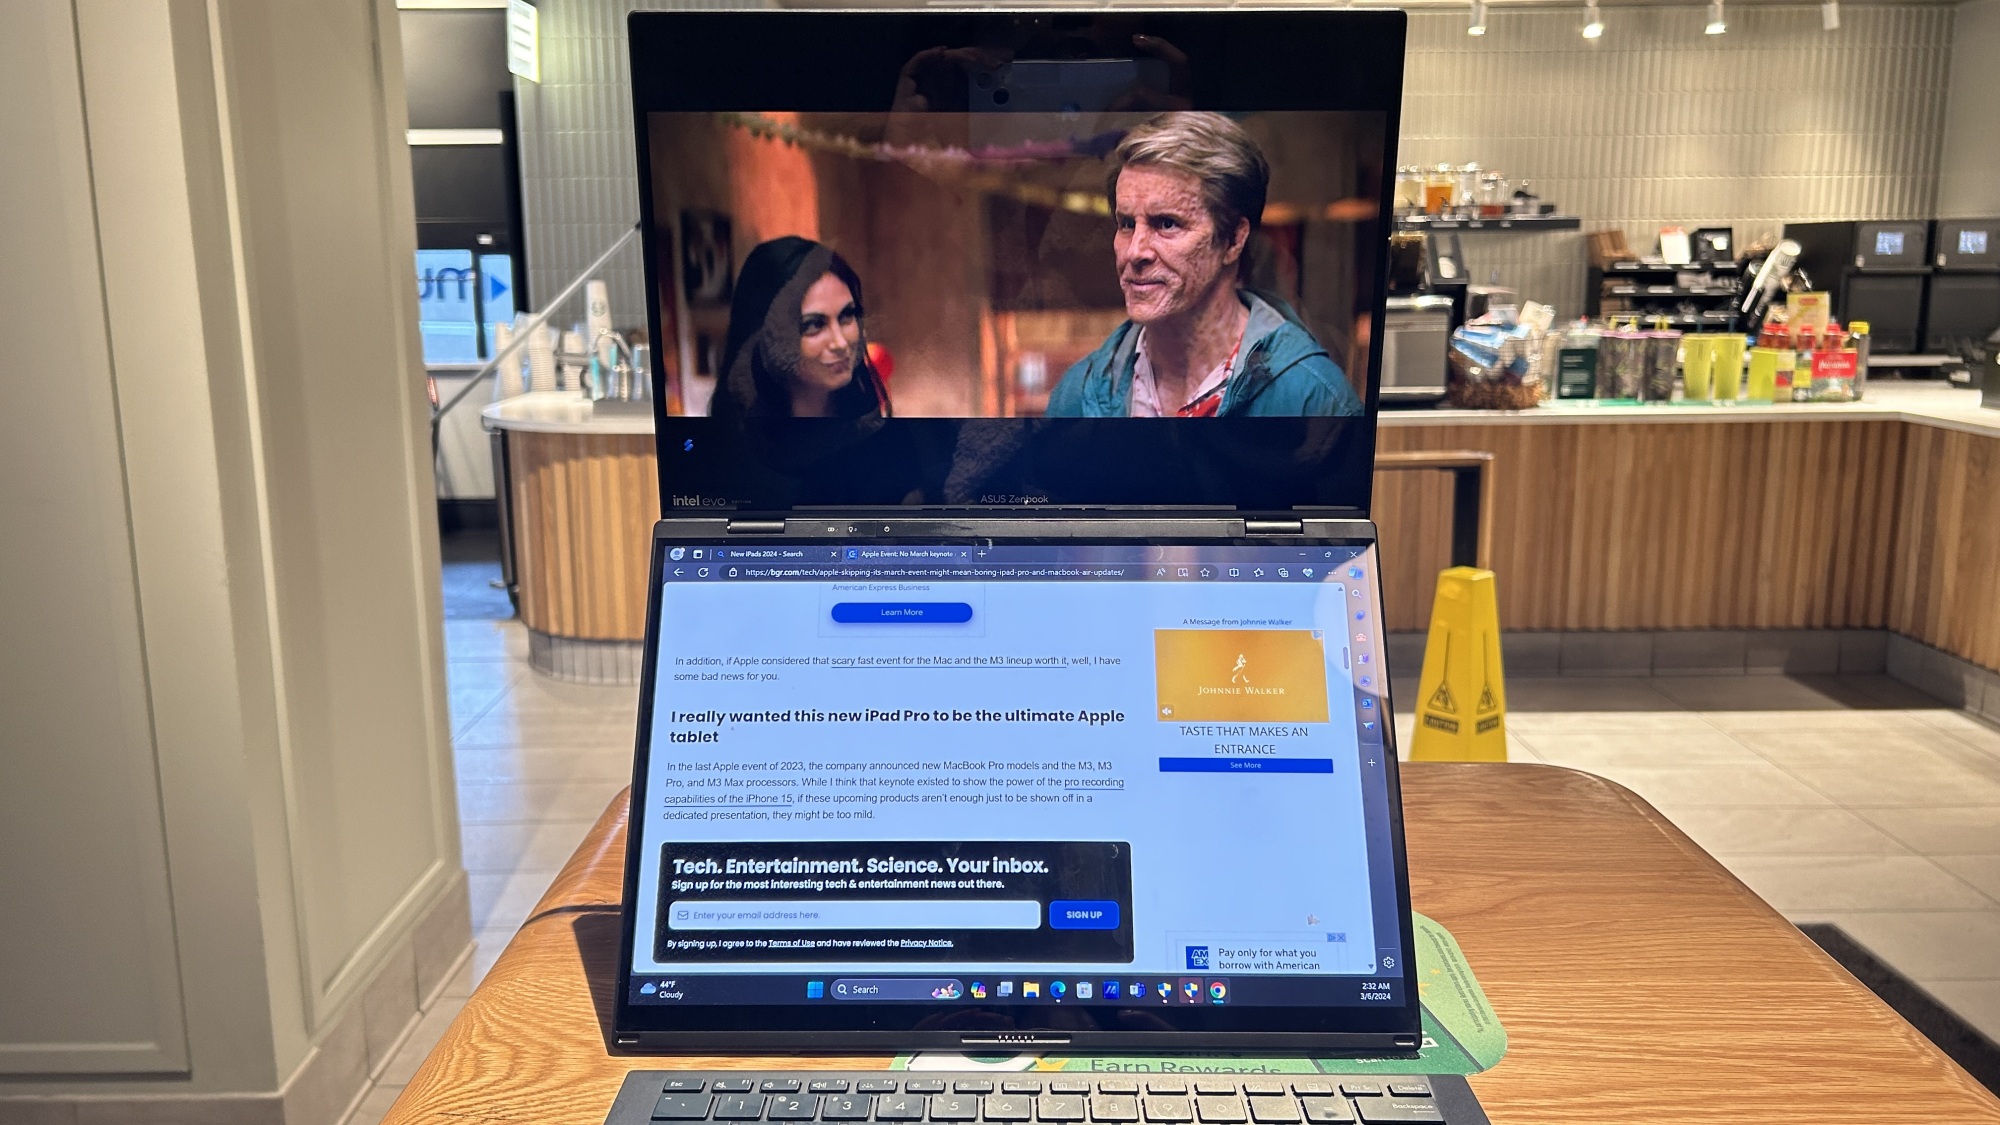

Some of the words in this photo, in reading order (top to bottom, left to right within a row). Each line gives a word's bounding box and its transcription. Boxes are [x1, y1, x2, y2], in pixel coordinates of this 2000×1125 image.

[673, 495, 700, 506] intel
[702, 498, 726, 506] evo
[980, 495, 1006, 503] ASUS
[1009, 495, 1049, 504] Zenbook
[745, 568, 1124, 578] https://bgr.com/tech/apple-skipping-its-march-event-might-mean-boring-ipad-pro-and-macbook-air-updates/
[868, 584, 897, 593] Express
[1189, 618, 1220, 627] Message
[1239, 618, 1267, 626] Johnnie
[675, 657, 684, 665] In
[686, 657, 724, 666] addition,
[733, 657, 759, 667] Apple
[760, 657, 809, 665] considered
[811, 656, 828, 665] that
[830, 658, 855, 667] scary
[856, 656, 873, 665] fast
[875, 657, 900, 665] event
[902, 656, 914, 665] for
[916, 656, 930, 665] the
[953, 656, 971, 664] and
[972, 656, 987, 664] the
[989, 656, 1003, 664] M3
[1005, 656, 1032, 666] lineup
[1034, 656, 1059, 664] worth
[1060, 656, 1069, 666] it,
[1071, 656, 1091, 666] well,
[1099, 656, 1121, 664] have
[1198, 686, 1241, 695] JOHNNIE
[1244, 686, 1285, 694] WALKER
[671, 711, 676, 723] I
[679, 710, 725, 727] really
[728, 710, 790, 723] wanted
[792, 709, 823, 723] this
[826, 713, 860, 723] new
[863, 709, 899, 722] iPad
[902, 710, 929, 722] Pro
[931, 710, 949, 722] to
[951, 710, 973, 722] be
[975, 709, 1003, 722] the
[1005, 709, 1075, 722] ultimate
[1077, 709, 1125, 726] Apple
[1179, 726, 1214, 736] TASTE
[1216, 727, 1246, 736] THAT
[1248, 727, 1289, 737] MAKES
[1291, 727, 1308, 737] AN
[669, 730, 719, 743] tablet
[1214, 744, 1276, 754] ENTRANCE
[667, 763, 676, 771] In
[678, 763, 693, 771] the
[695, 763, 712, 771] last
[713, 763, 740, 773] Apple
[742, 763, 767, 771] event
[769, 762, 778, 771] of
[780, 763, 806, 772] 2023,
[808, 762, 823, 771] the
[825, 764, 867, 773] company
[869, 762, 920, 771] announced
[943, 762, 986, 770] MacBook
[988, 762, 1004, 770] Pro
[1006, 762, 1040, 770] models
[1041, 762, 1059, 770] and
[1061, 762, 1076, 770] the
[1078, 762, 1096, 771] M3,
[1098, 762, 1112, 770] M3
[663, 811, 708, 820] dedicated
[710, 811, 770, 822] presentation,
[772, 811, 792, 821] they
[794, 811, 820, 821] might
[821, 811, 834, 819] be
[836, 811, 851, 819] too
[852, 811, 875, 819] mild.
[672, 860, 722, 874] Tech.
[725, 858, 863, 874] Entertainment.
[866, 858, 943, 873] Science.
[946, 860, 989, 873] Your
[992, 858, 1049, 873] inbox.
[671, 880, 693, 891] Sign
[695, 882, 708, 891] up
[710, 880, 724, 889] for
[725, 881, 742, 889] the
[743, 881, 769, 889] most
[770, 880, 823, 891] interesting
[825, 880, 847, 888] tech
[848, 880, 857, 888] &
[858, 880, 929, 888] entertainment
[958, 880, 975, 888] out
[976, 880, 1005, 888] there.
[716, 913, 736, 921] your
[1066, 911, 1089, 919] SIGN
[1090, 911, 1103, 919] UP
[1192, 949, 1209, 958] AM
[1218, 949, 1235, 959] Pay
[1237, 949, 1257, 959] only
[1258, 949, 1272, 957] for
[1274, 949, 1297, 957] what
[1299, 951, 1316, 959] you
[1218, 961, 1252, 970] borrow
[1254, 961, 1275, 970] with
[1276, 962, 1320, 970] American
[853, 985, 879, 994] Search
[1362, 982, 1376, 990] 2:32
[1378, 982, 1390, 990] AM
[659, 990, 683, 1000] Cloudy
[1360, 992, 1391, 1000] 3/6/2024
[1091, 1059, 1150, 1072] Earn
[1160, 1061, 1282, 1073] Rewards
[740, 1101, 743, 1109] 1
[789, 1102, 799, 1110] 2
[842, 1102, 852, 1110] 3
[895, 1102, 906, 1110] 4
[1056, 1103, 1065, 1111] 7
[1392, 1103, 1433, 1111] Backspace
